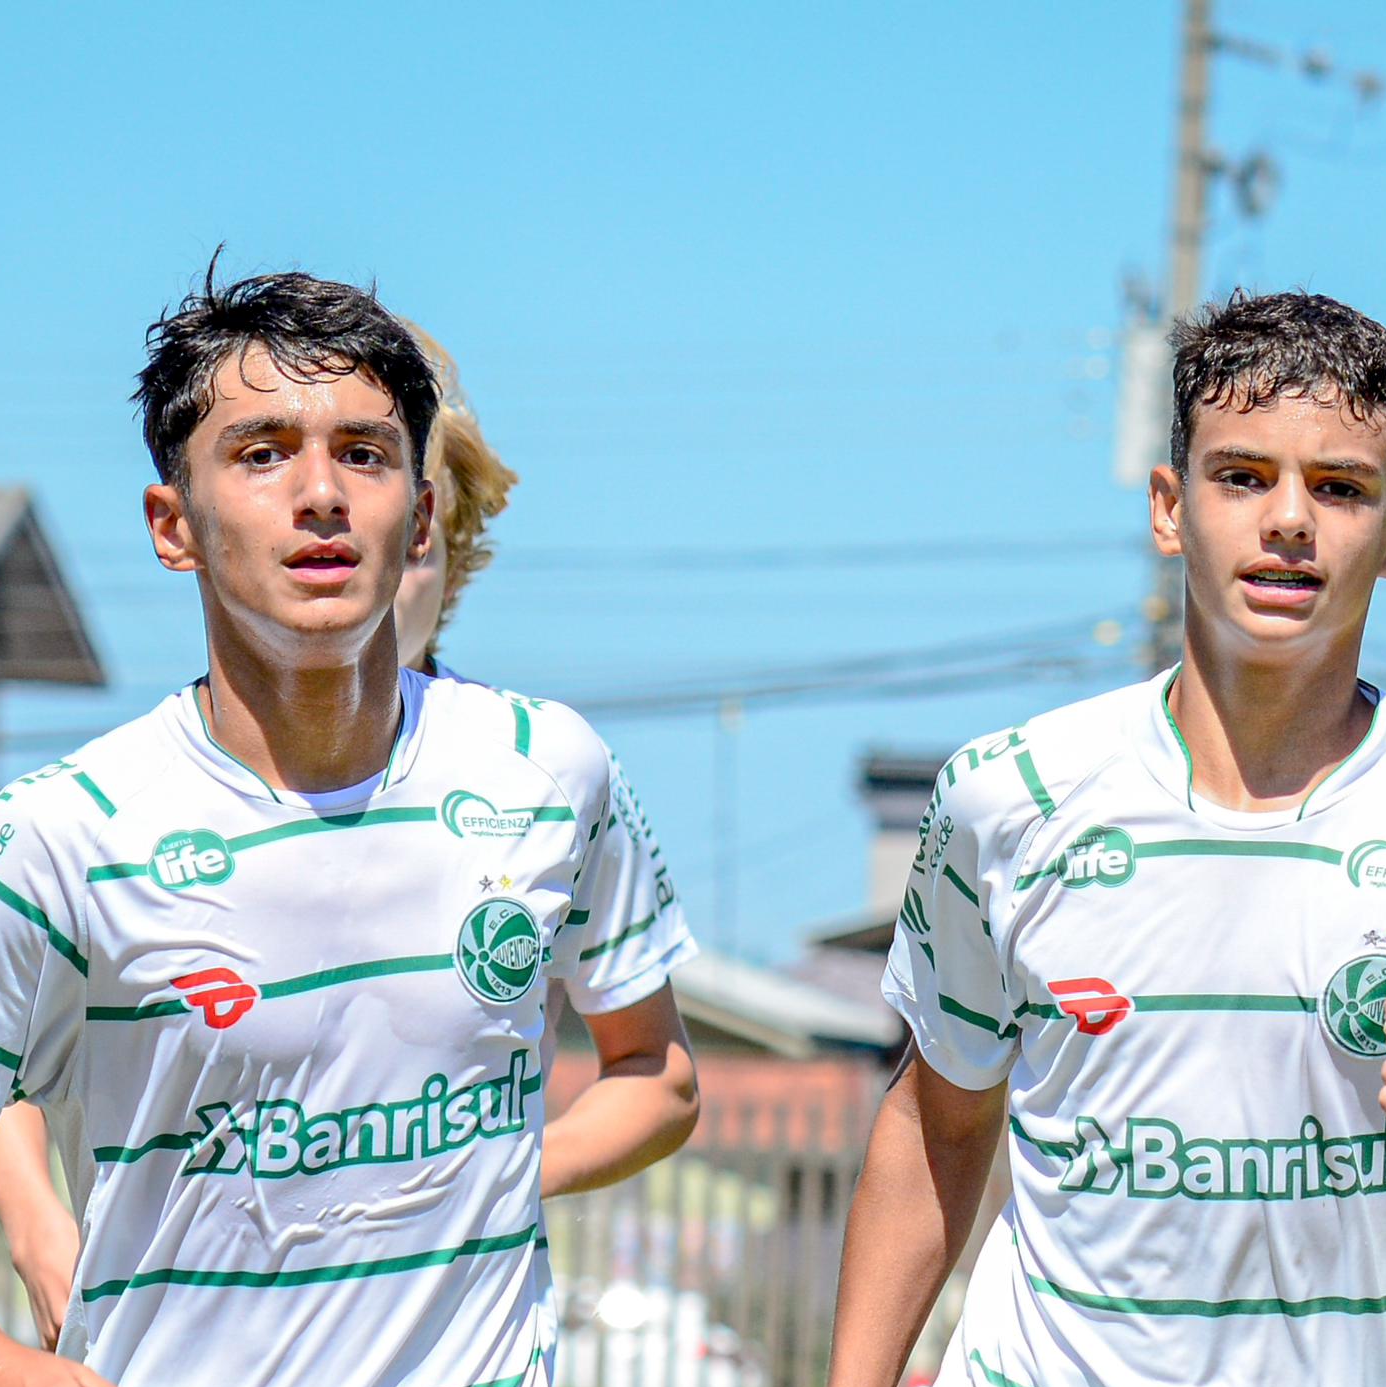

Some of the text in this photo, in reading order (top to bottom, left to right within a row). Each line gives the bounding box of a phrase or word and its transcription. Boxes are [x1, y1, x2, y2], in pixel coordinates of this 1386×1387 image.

[462, 816, 531, 830] EFFICIENZA
[154, 844, 225, 884] life
[1063, 842, 1128, 880] life
[253, 1049, 529, 1179] Banrisul
